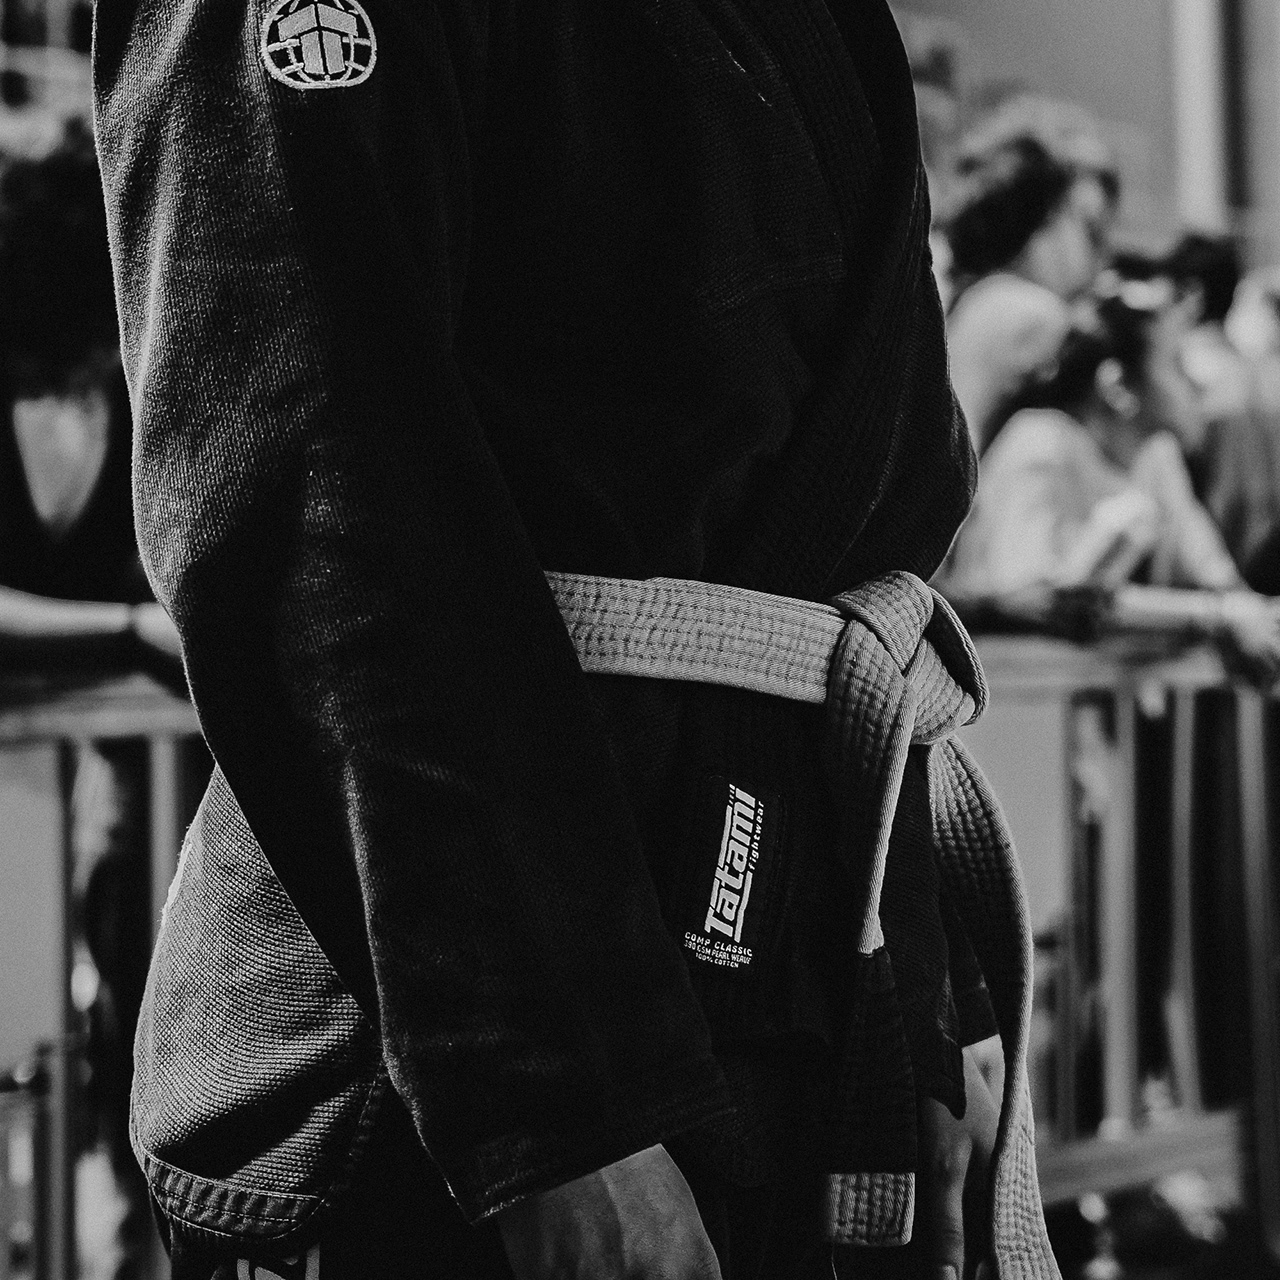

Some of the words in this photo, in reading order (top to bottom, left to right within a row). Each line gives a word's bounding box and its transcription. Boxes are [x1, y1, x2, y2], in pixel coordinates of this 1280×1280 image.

[748, 801, 764, 870] fightwear
[704, 788, 756, 938] Tatami
[684, 932, 711, 946] COMP
[714, 941, 753, 957] CLASSIC
[712, 949, 730, 960] PEARL
[695, 952, 713, 963] 100%
